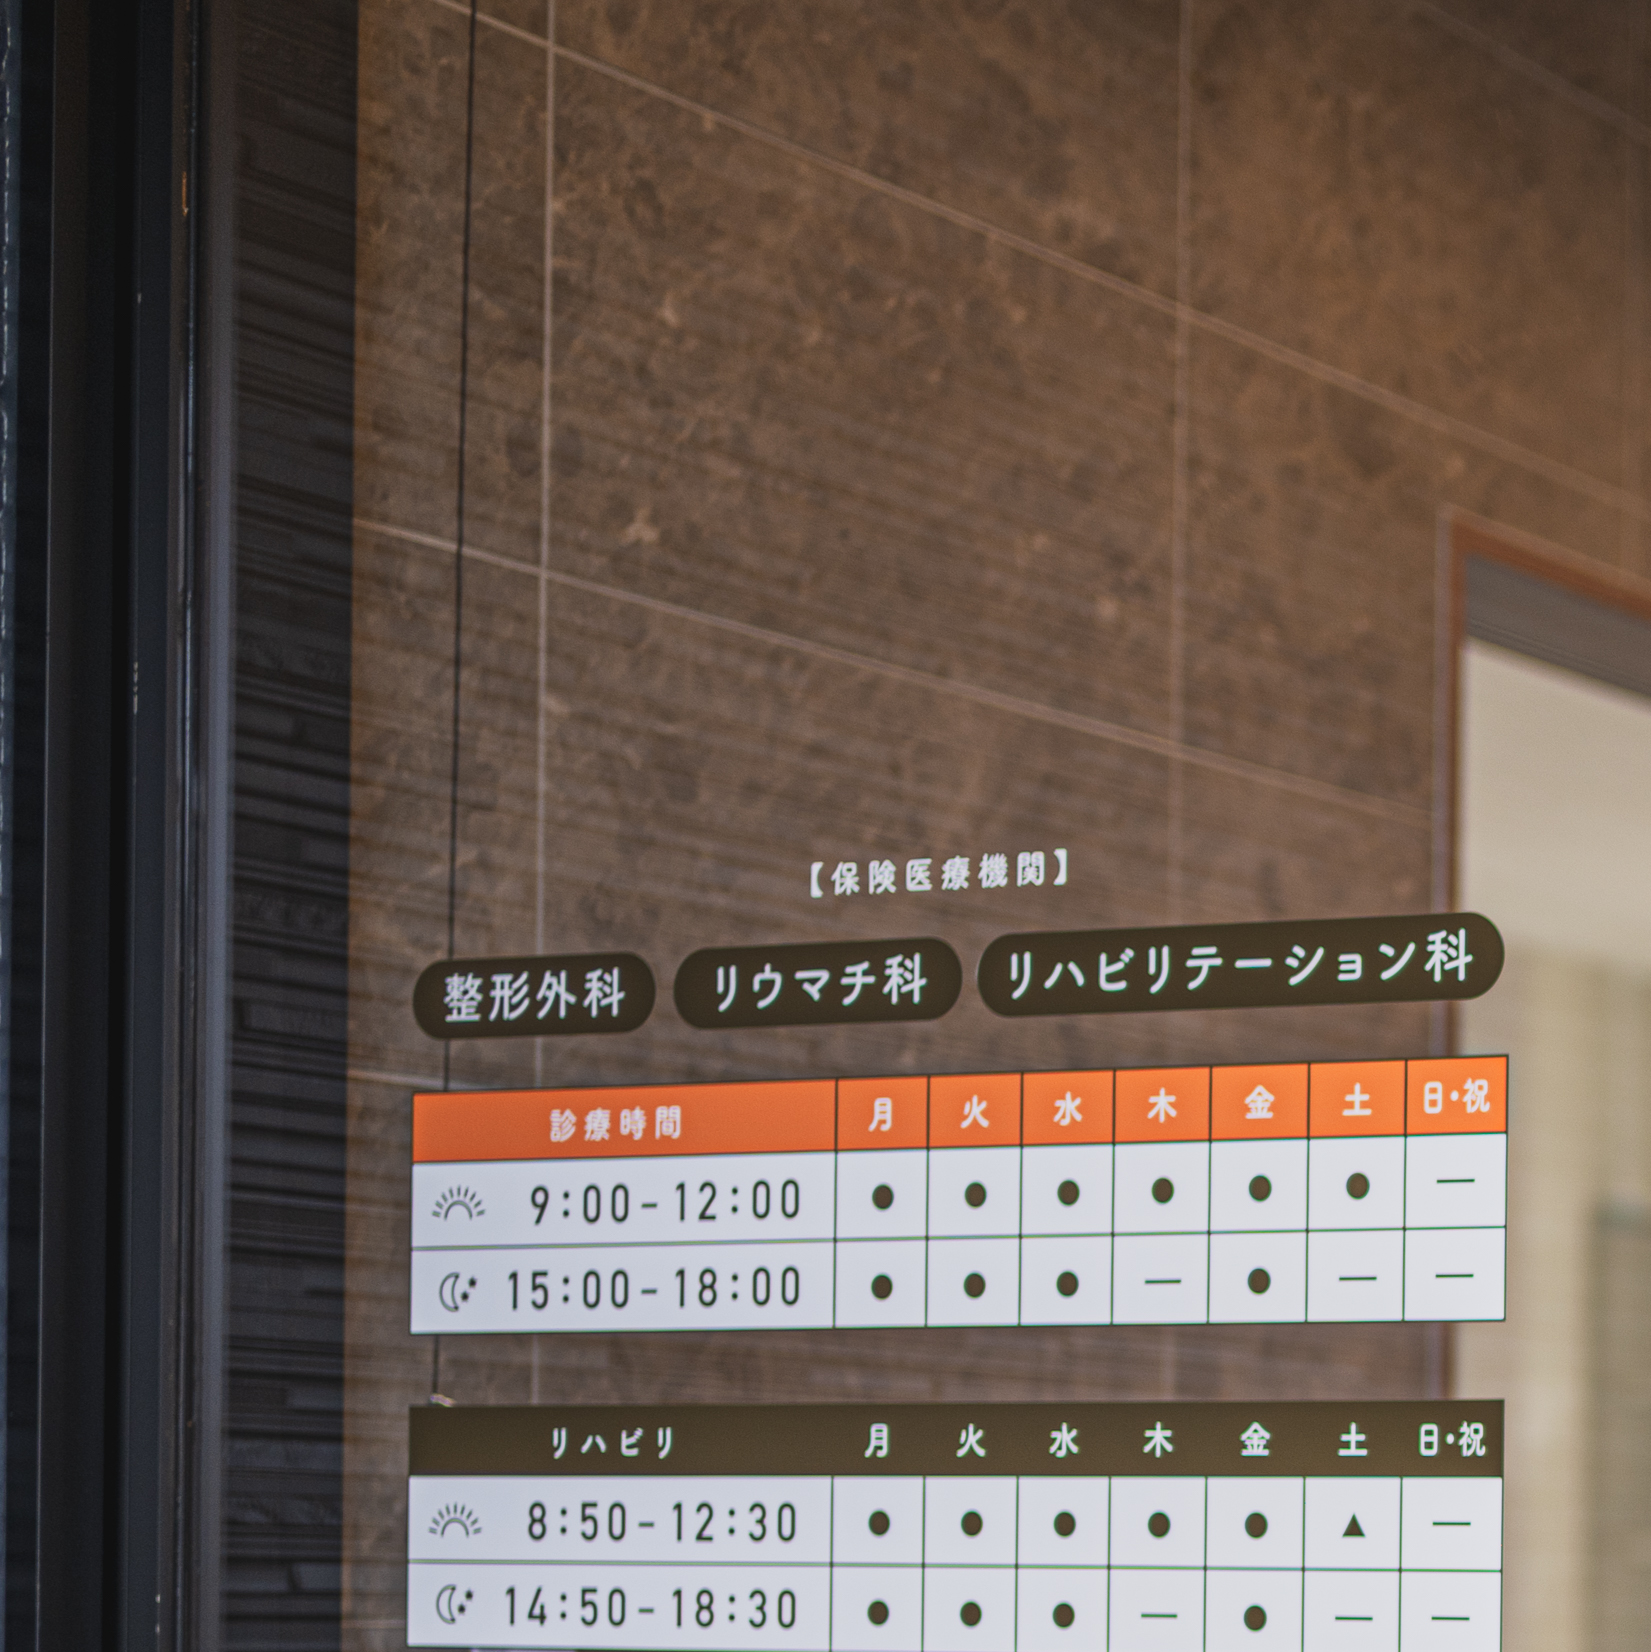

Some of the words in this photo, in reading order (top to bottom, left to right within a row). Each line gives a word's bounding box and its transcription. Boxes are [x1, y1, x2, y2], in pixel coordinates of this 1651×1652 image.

[717, 953, 929, 1013] リウマチ科
[1009, 928, 1474, 1000] リハビリテーション科
[443, 967, 626, 1023] 整形外科
[549, 1106, 682, 1142] 診療時間
[868, 1097, 893, 1132] 月
[960, 1095, 990, 1129] 火
[1053, 1091, 1083, 1126] 水
[1147, 1088, 1177, 1124] 木
[1244, 1085, 1275, 1120] 金
[1342, 1083, 1373, 1117] 土
[530, 1178, 801, 1226] 9:00-12:00
[507, 1266, 801, 1312] 15:00-18:00
[551, 1426, 673, 1459] リハビリ
[864, 1423, 890, 1459] 月
[956, 1423, 986, 1457] 火
[1049, 1423, 1080, 1459] 水
[1142, 1422, 1174, 1459] 木
[1240, 1422, 1271, 1457] 金
[1337, 1422, 1368, 1457] 土
[527, 1501, 797, 1543] 8:50-12:30
[504, 1586, 797, 1628] 14:50-18:30
